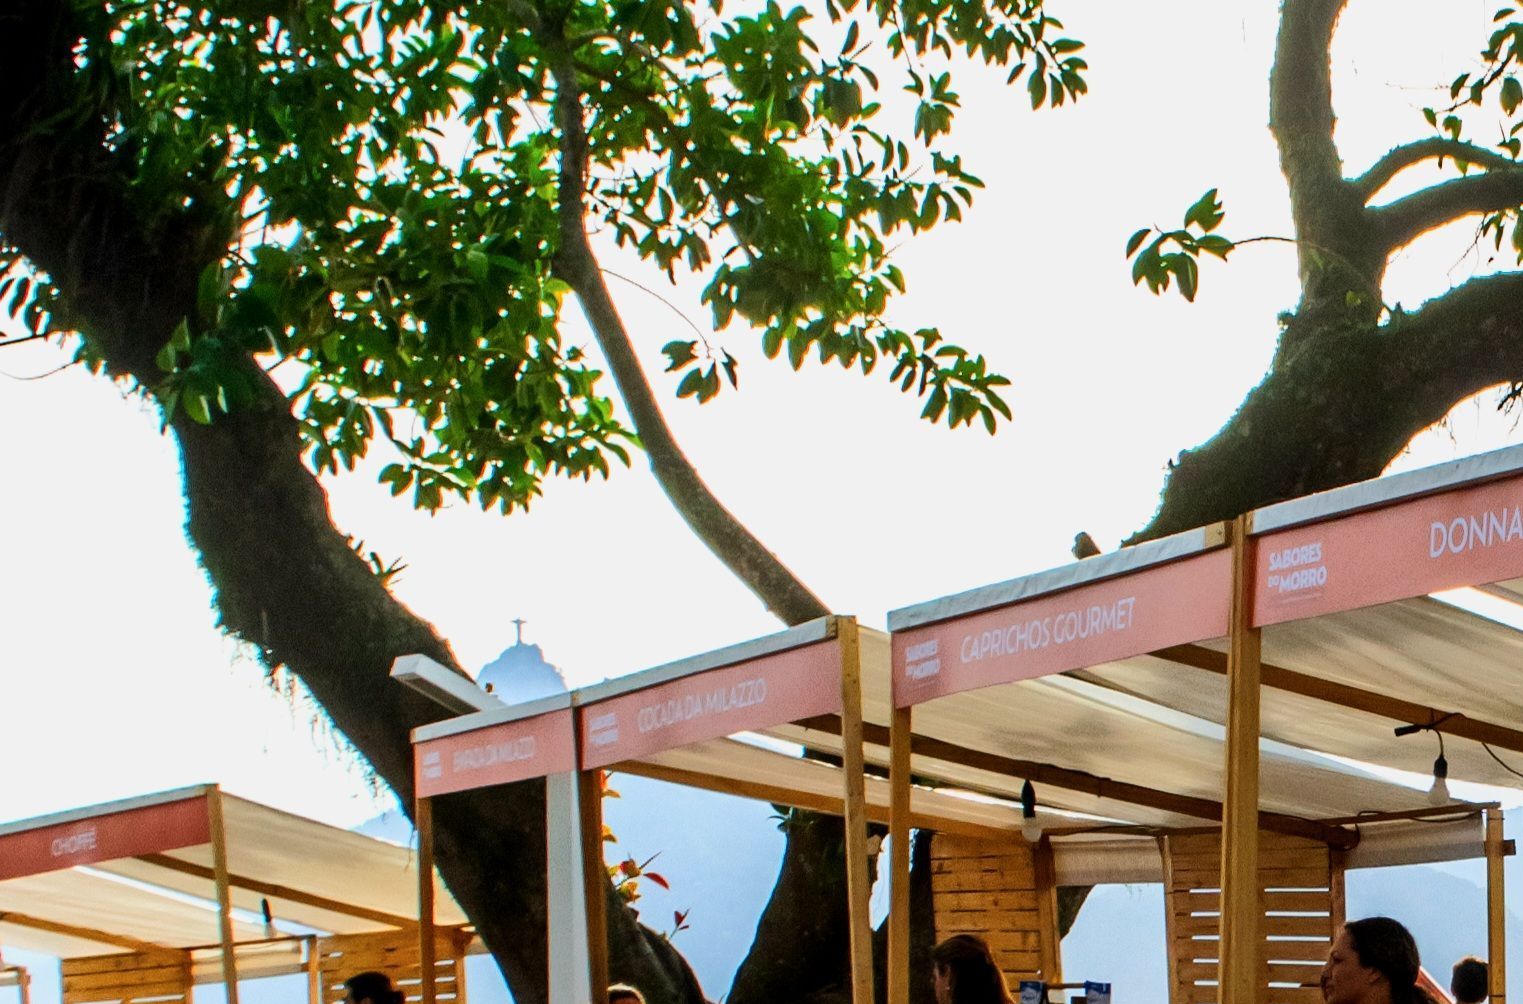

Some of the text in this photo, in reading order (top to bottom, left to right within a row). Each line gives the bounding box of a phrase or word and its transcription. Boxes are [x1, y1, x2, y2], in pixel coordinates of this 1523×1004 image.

[1269, 542, 1322, 572] SABORES
[1279, 566, 1327, 592] MORRO
[960, 597, 1136, 664] CAPRICHOS GOURMET
[703, 678, 768, 713] MILAZZO
